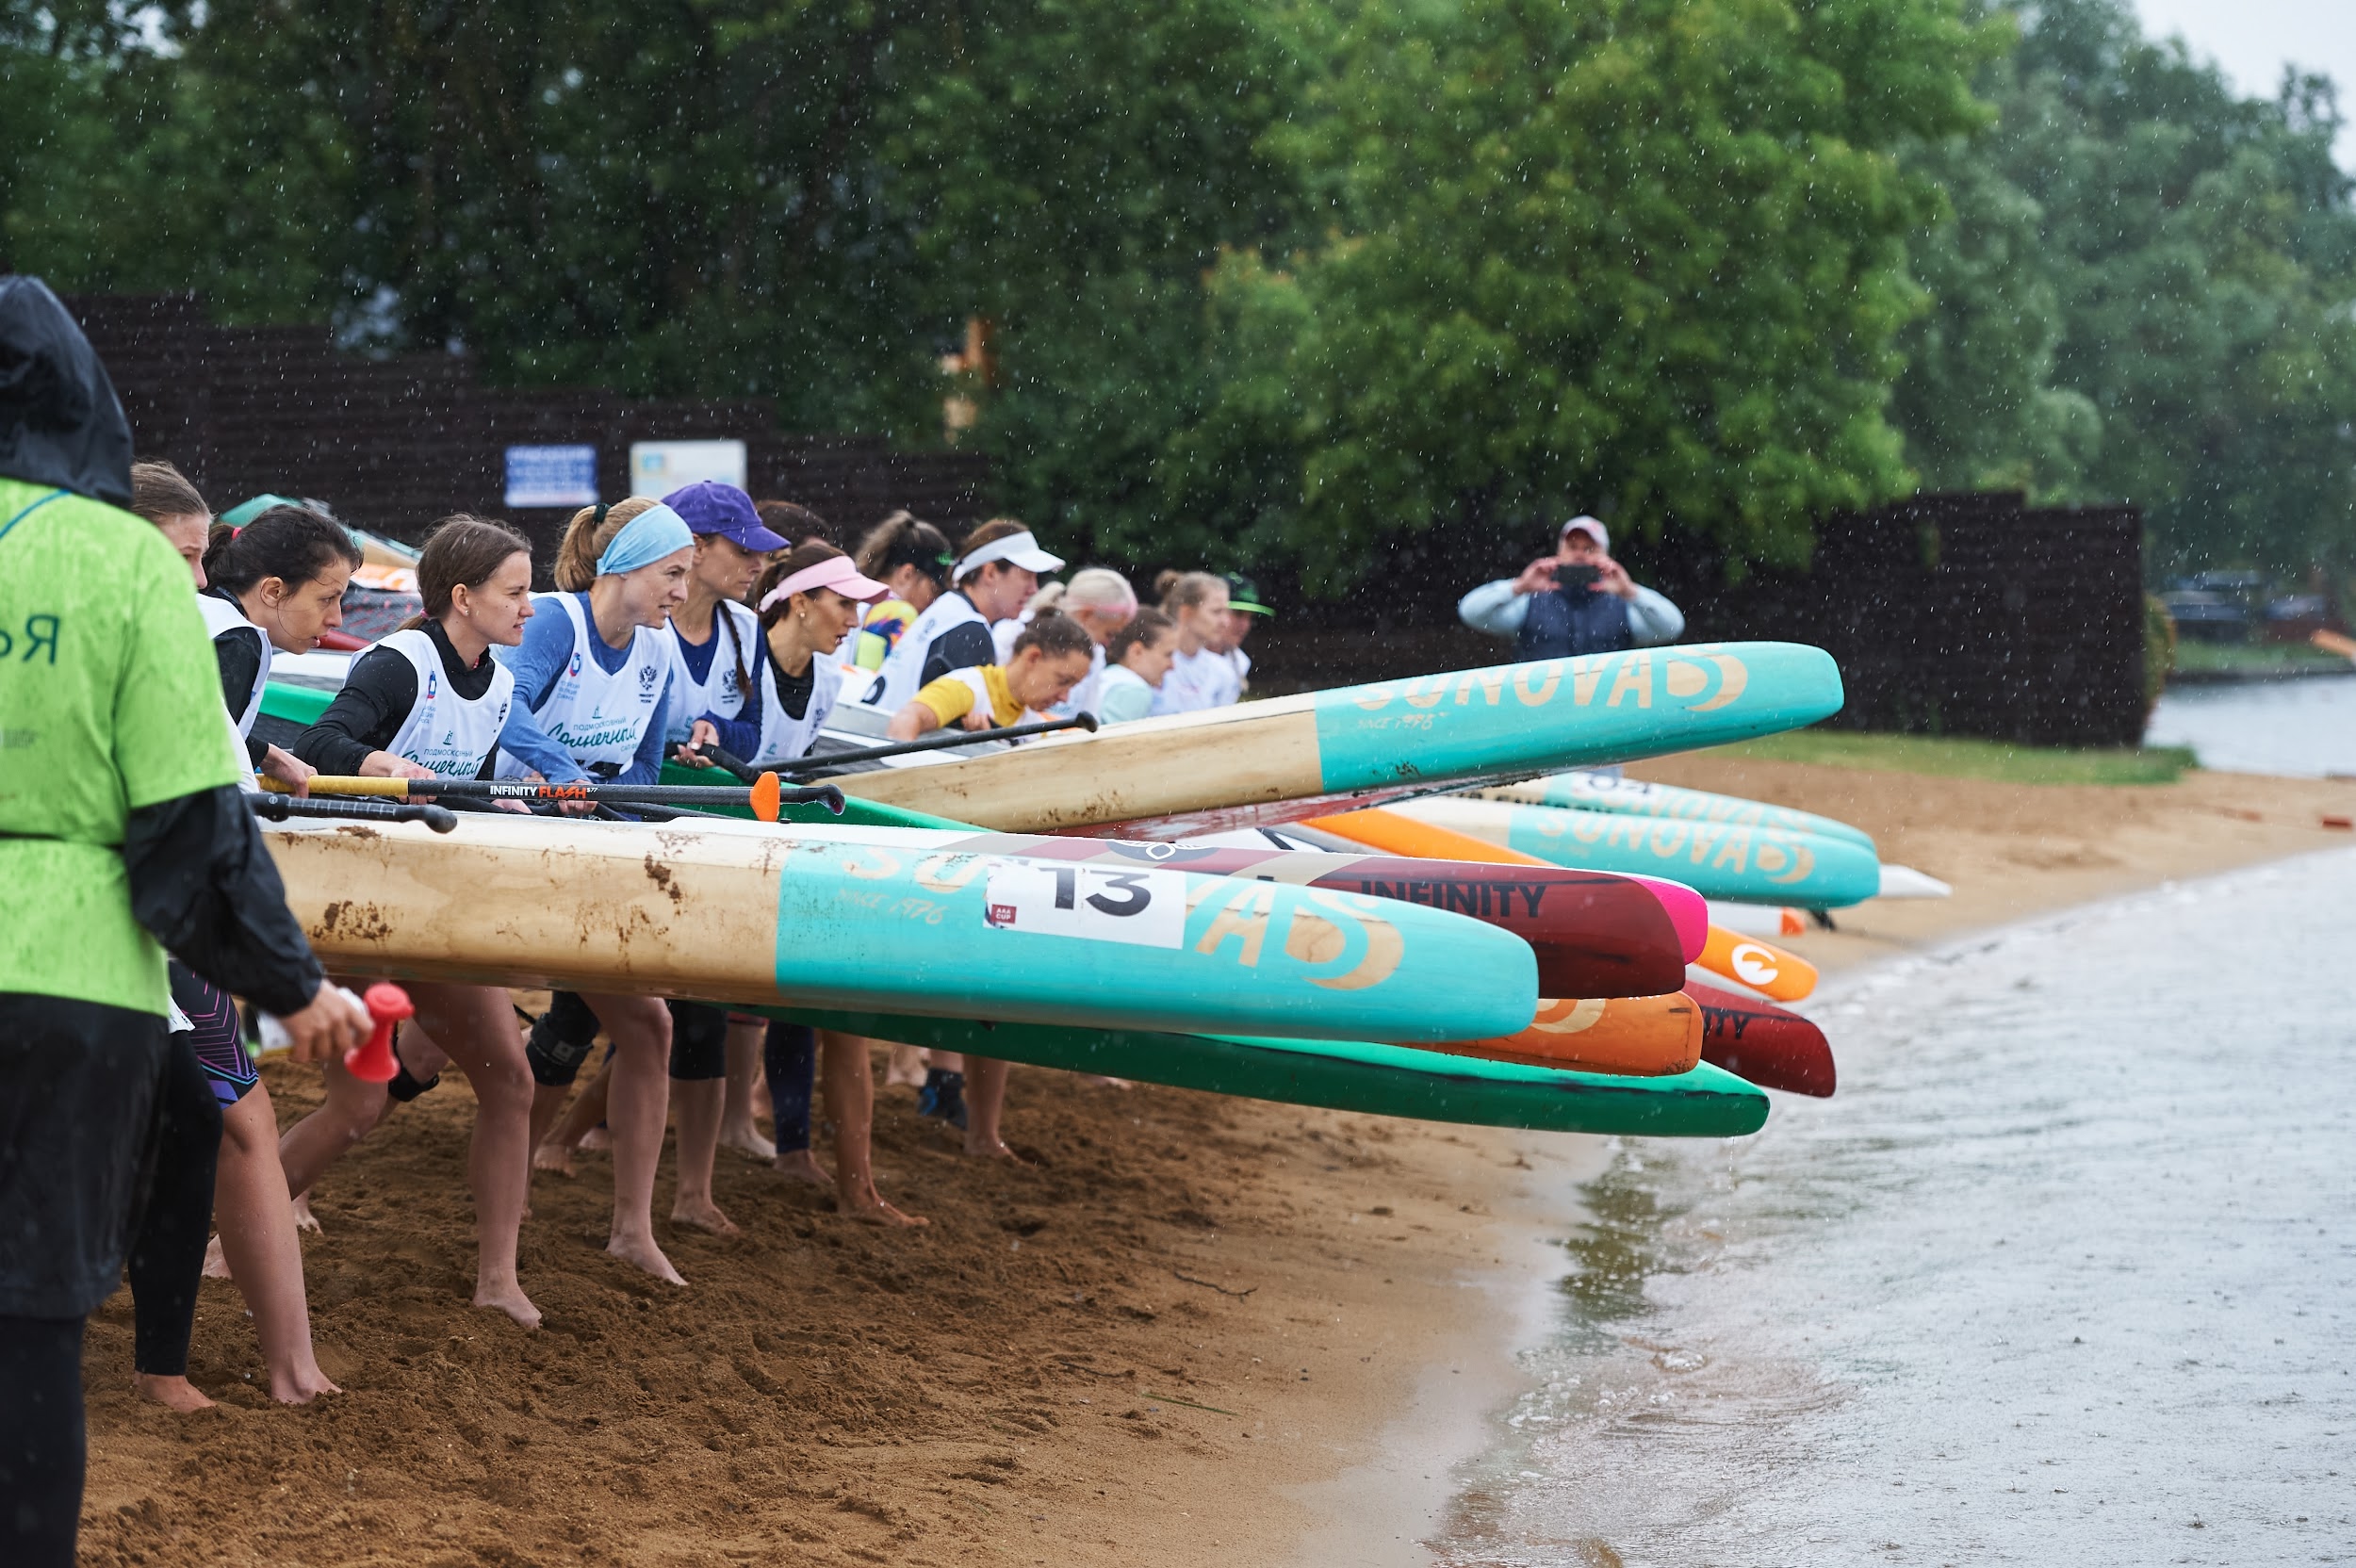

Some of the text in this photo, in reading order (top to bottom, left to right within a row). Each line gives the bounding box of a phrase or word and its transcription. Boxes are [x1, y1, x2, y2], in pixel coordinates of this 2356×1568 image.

[1351, 649, 1653, 710] SUNOVA
[423, 748, 474, 757] ПОДМОСКОНЫЙ
[490, 785, 537, 796] INFINITY
[538, 786, 586, 799] FLASH
[1536, 810, 1753, 874] SUNOVA
[889, 896, 950, 925] 1976
[1038, 866, 1152, 917] 13
